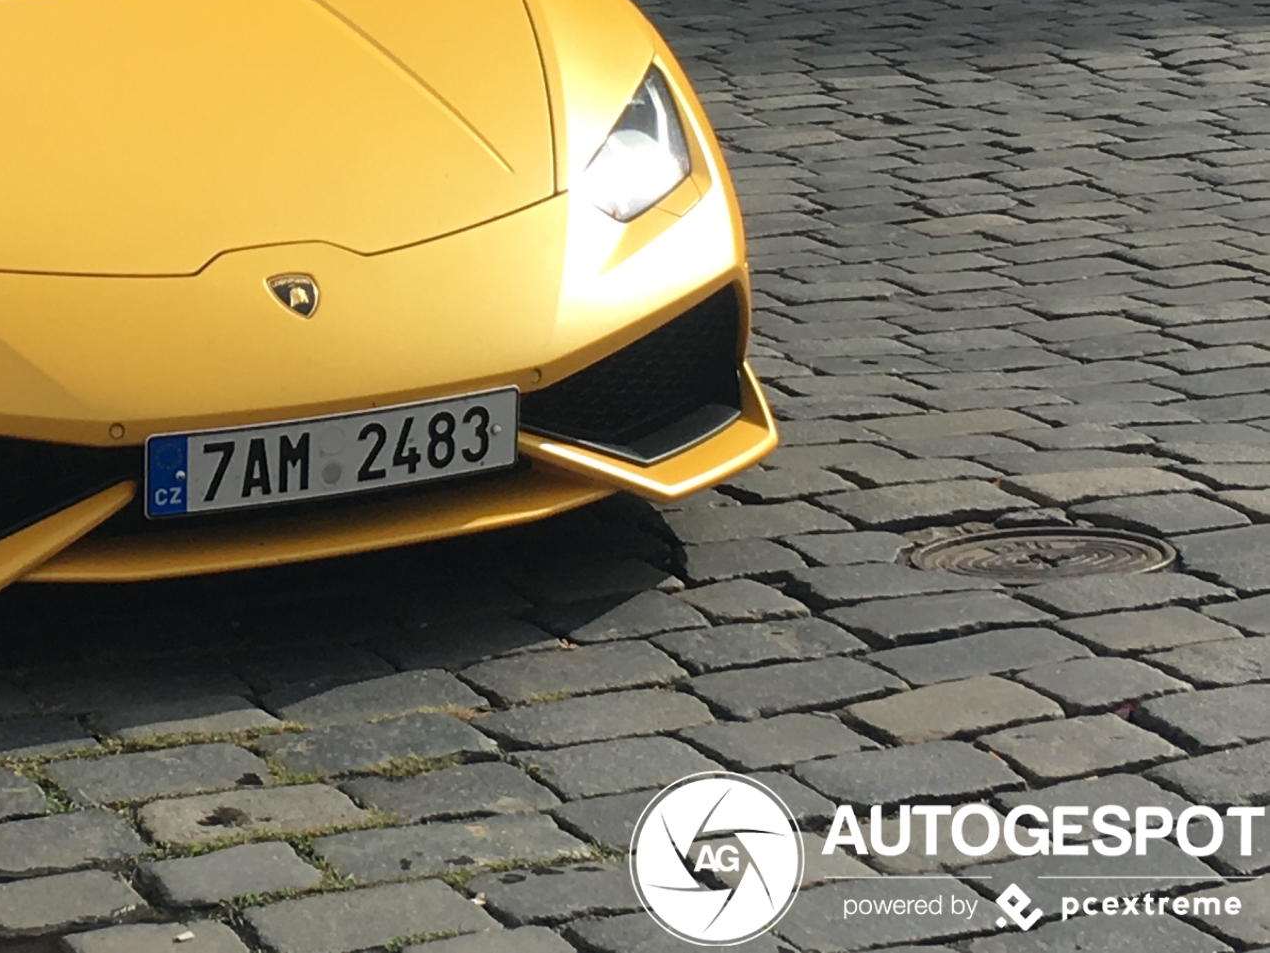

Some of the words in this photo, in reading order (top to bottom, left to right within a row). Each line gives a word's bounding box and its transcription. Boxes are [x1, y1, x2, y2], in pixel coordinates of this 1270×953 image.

[202, 432, 311, 503] 7AM
[356, 405, 491, 484] 2483
[155, 486, 182, 506] CZ
